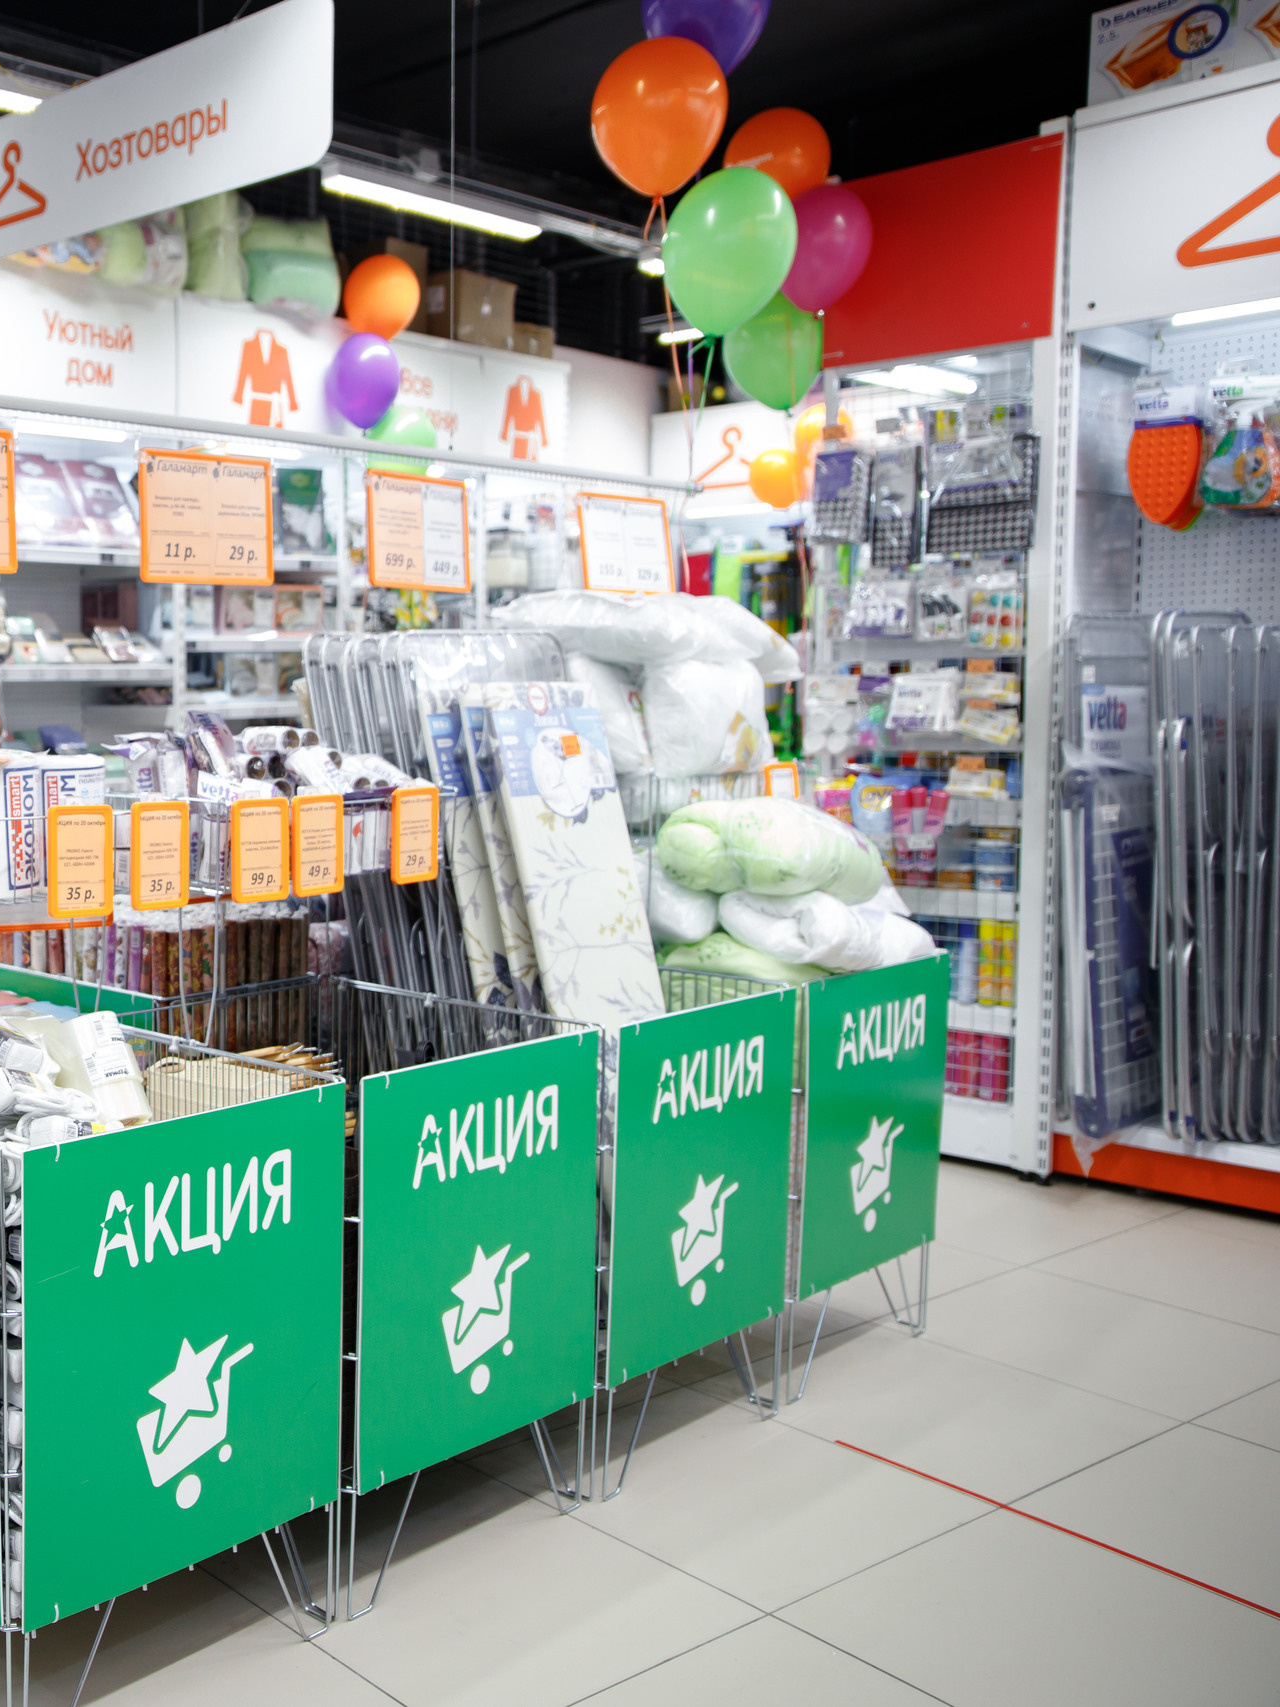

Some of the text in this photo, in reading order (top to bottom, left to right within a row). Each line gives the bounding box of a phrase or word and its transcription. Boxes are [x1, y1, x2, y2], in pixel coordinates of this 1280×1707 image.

[76, 98, 228, 182] Хозтовары
[43, 308, 135, 353] Уютный
[1212, 386, 1244, 397] vetta
[1139, 400, 1169, 411] vetta
[157, 460, 207, 477] Галамарт
[165, 543, 196, 561] 11 р.
[229, 546, 258, 563] 29 р.
[386, 553, 416, 570] 699 р.
[433, 561, 450, 573] 449
[1088, 697, 1127, 730] vetta
[12, 777, 21, 817] smart
[406, 854, 426, 868] 29 р.
[251, 872, 276, 886] 99 р.
[308, 865, 330, 878] 49 р.
[66, 886, 95, 902] 35 р.
[150, 878, 175, 894] 35 р.
[837, 994, 926, 1070] АКЦИЯ
[652, 1035, 764, 1124] АКЦИЯ
[413, 1084, 559, 1189] АКЦИЯ
[94, 1149, 292, 1278] АКЦИЯ
